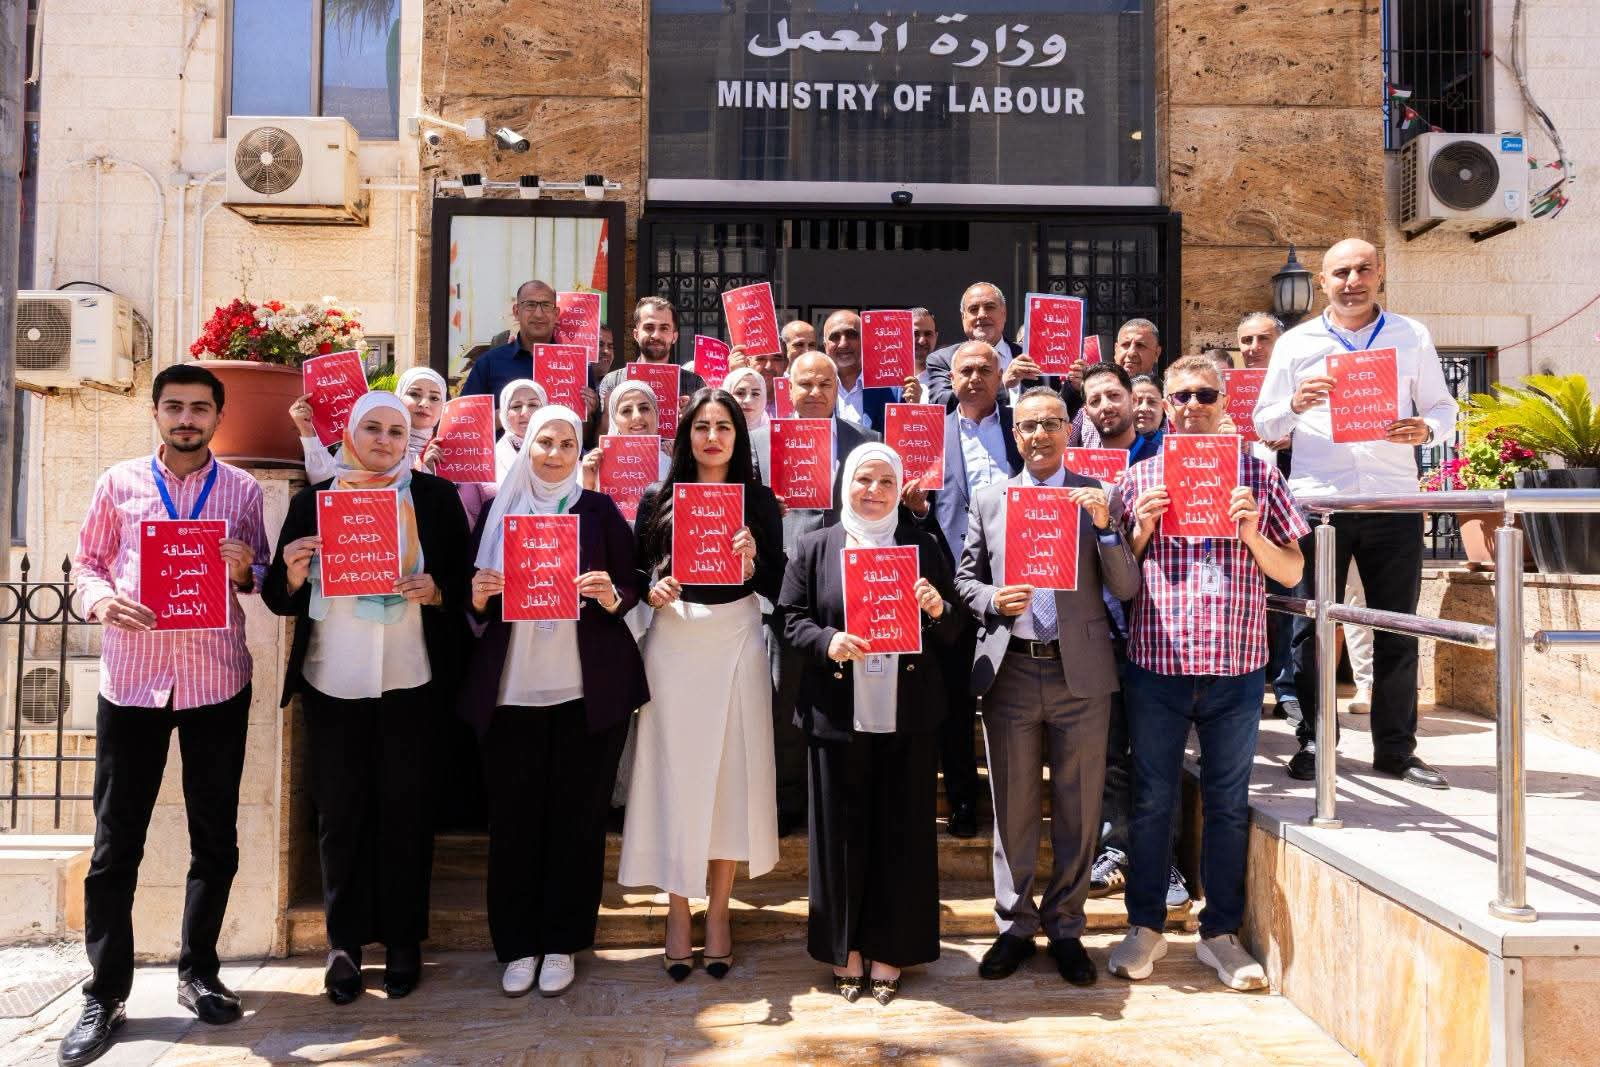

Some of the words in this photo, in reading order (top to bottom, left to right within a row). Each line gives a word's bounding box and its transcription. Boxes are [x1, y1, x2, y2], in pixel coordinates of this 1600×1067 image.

[748, 18, 907, 56] العمل
[930, 13, 1066, 67] وزارة
[717, 80, 879, 111] MINISTRY
[893, 84, 932, 112] OF
[949, 86, 1085, 114] LABOUR
[566, 306, 585, 314] RED
[562, 319, 589, 327] CARD
[1044, 314, 1069, 325] البطاقة
[569, 332, 596, 340] CHILD
[875, 327, 900, 338] البطاقة
[1042, 328, 1070, 339] الحمراء
[874, 341, 902, 352] الحمراء
[1047, 342, 1065, 351] لعمل
[880, 354, 898, 364] لعمل
[1041, 353, 1069, 364] الأطفال
[876, 367, 903, 379] الأطفال
[1348, 372, 1376, 381] RED
[316, 374, 347, 387] البطاقة
[319, 389, 354, 404] الحمراء
[1344, 388, 1383, 398] CARD
[1333, 407, 1349, 415] TO
[1354, 403, 1394, 413] CHILD
[451, 416, 475, 424] RED
[785, 437, 815, 450] البطاقة
[784, 455, 817, 467] الحمراء
[907, 455, 941, 463] CHILD
[1183, 457, 1218, 470] البطاقة
[790, 471, 811, 482] لعمل
[1180, 475, 1220, 490] الحمراء
[784, 486, 816, 499] الأطفال
[1187, 494, 1212, 507] لعمل
[691, 506, 724, 519] البطاقة
[1024, 508, 1058, 523] البطاقة
[1179, 511, 1219, 525] الأطفال
[343, 515, 375, 525] RED
[689, 524, 727, 539] الحمراء
[1022, 528, 1061, 542] الحمراء
[338, 534, 381, 544] CARD
[522, 537, 558, 551] البطاقة
[162, 544, 205, 558] البطاقة
[696, 542, 720, 555] لعمل
[1028, 545, 1054, 558] لعمل
[324, 554, 345, 564] TO
[350, 552, 396, 563] CHILD
[520, 556, 560, 572] الحمراء
[161, 563, 208, 579] الحمراء
[690, 559, 726, 573] الأطفال
[1021, 562, 1059, 576] الأطفال
[329, 571, 395, 583] LABOUR
[528, 576, 553, 589] لعمل
[864, 569, 899, 584] البطاقة
[170, 582, 199, 598] لعمل
[521, 592, 560, 608] الأطفال
[863, 589, 902, 605] الحمراء
[161, 600, 207, 618] الأطفال
[871, 608, 896, 622] لعمل
[864, 624, 902, 642] الأطفال
